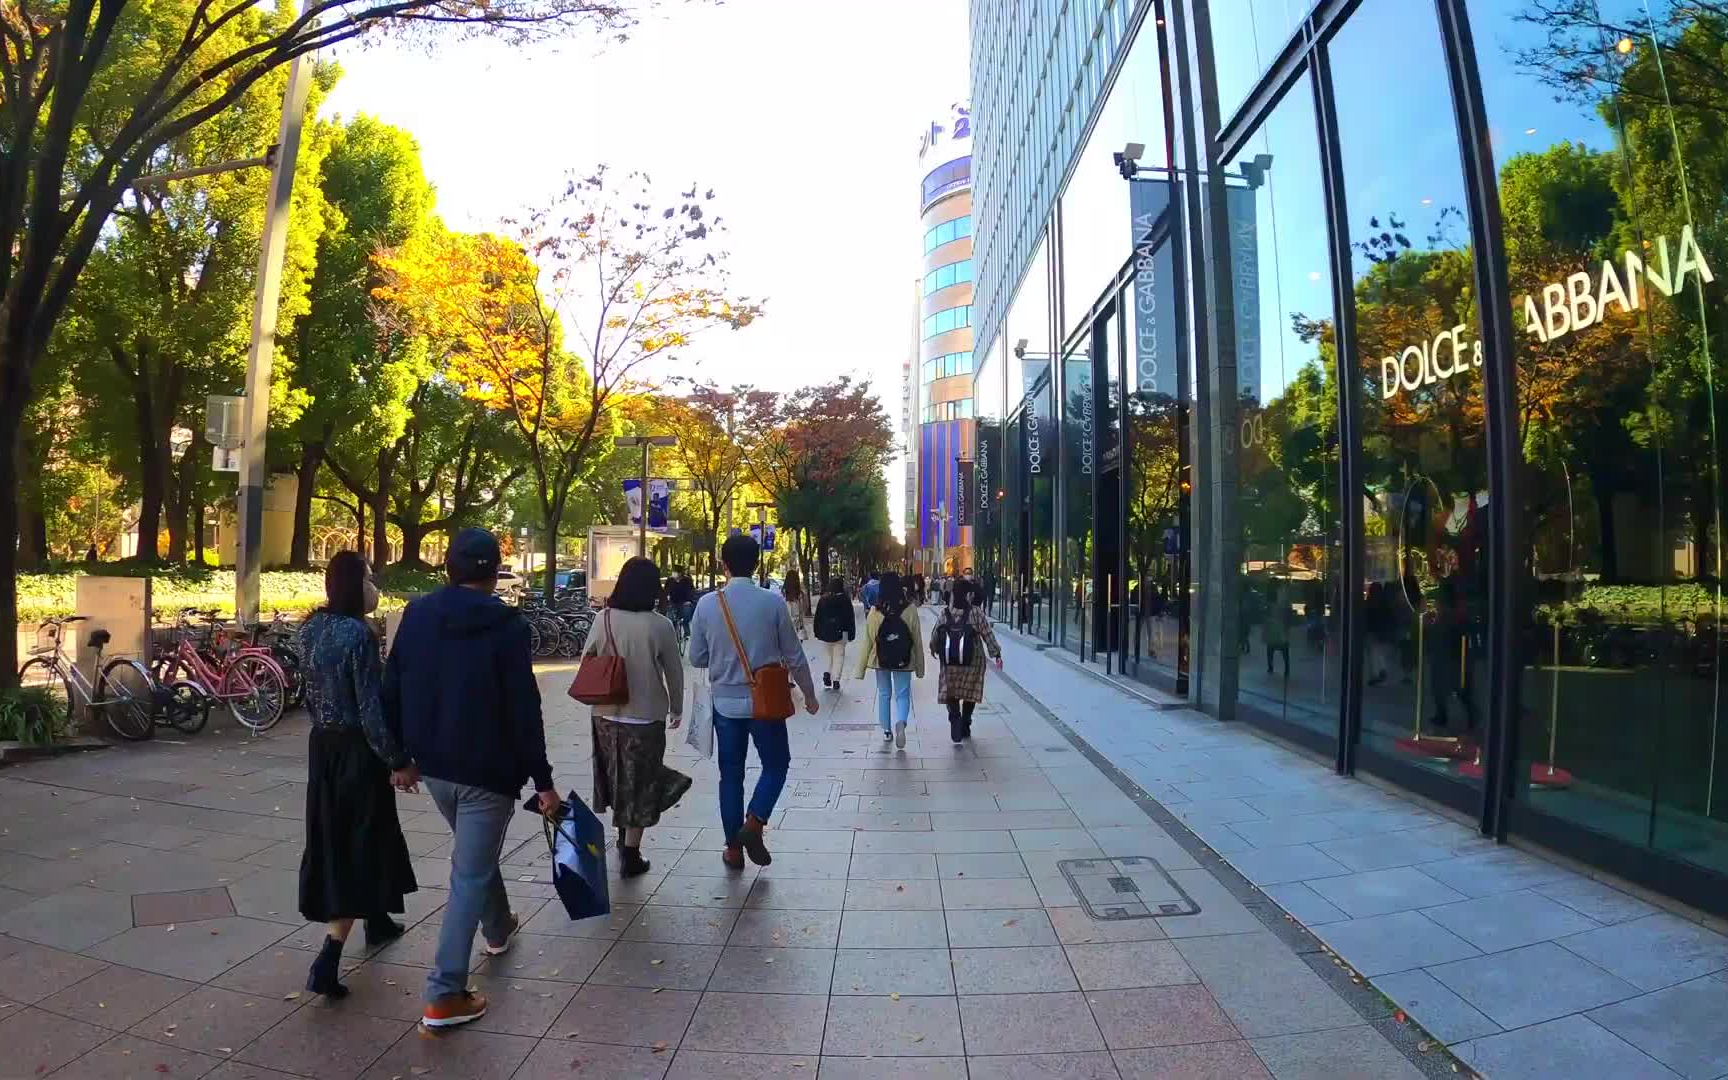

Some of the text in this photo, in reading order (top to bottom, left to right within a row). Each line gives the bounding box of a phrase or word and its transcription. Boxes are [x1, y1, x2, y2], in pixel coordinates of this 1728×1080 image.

[1135, 212, 1157, 392] DOLCE & GABBANA
[1381, 224, 1715, 400] DOLCE & ABBANA
[980, 440, 988, 479] GABBANA
[1028, 437, 1041, 473] DOLCE
[980, 482, 988, 509] DOLCE
